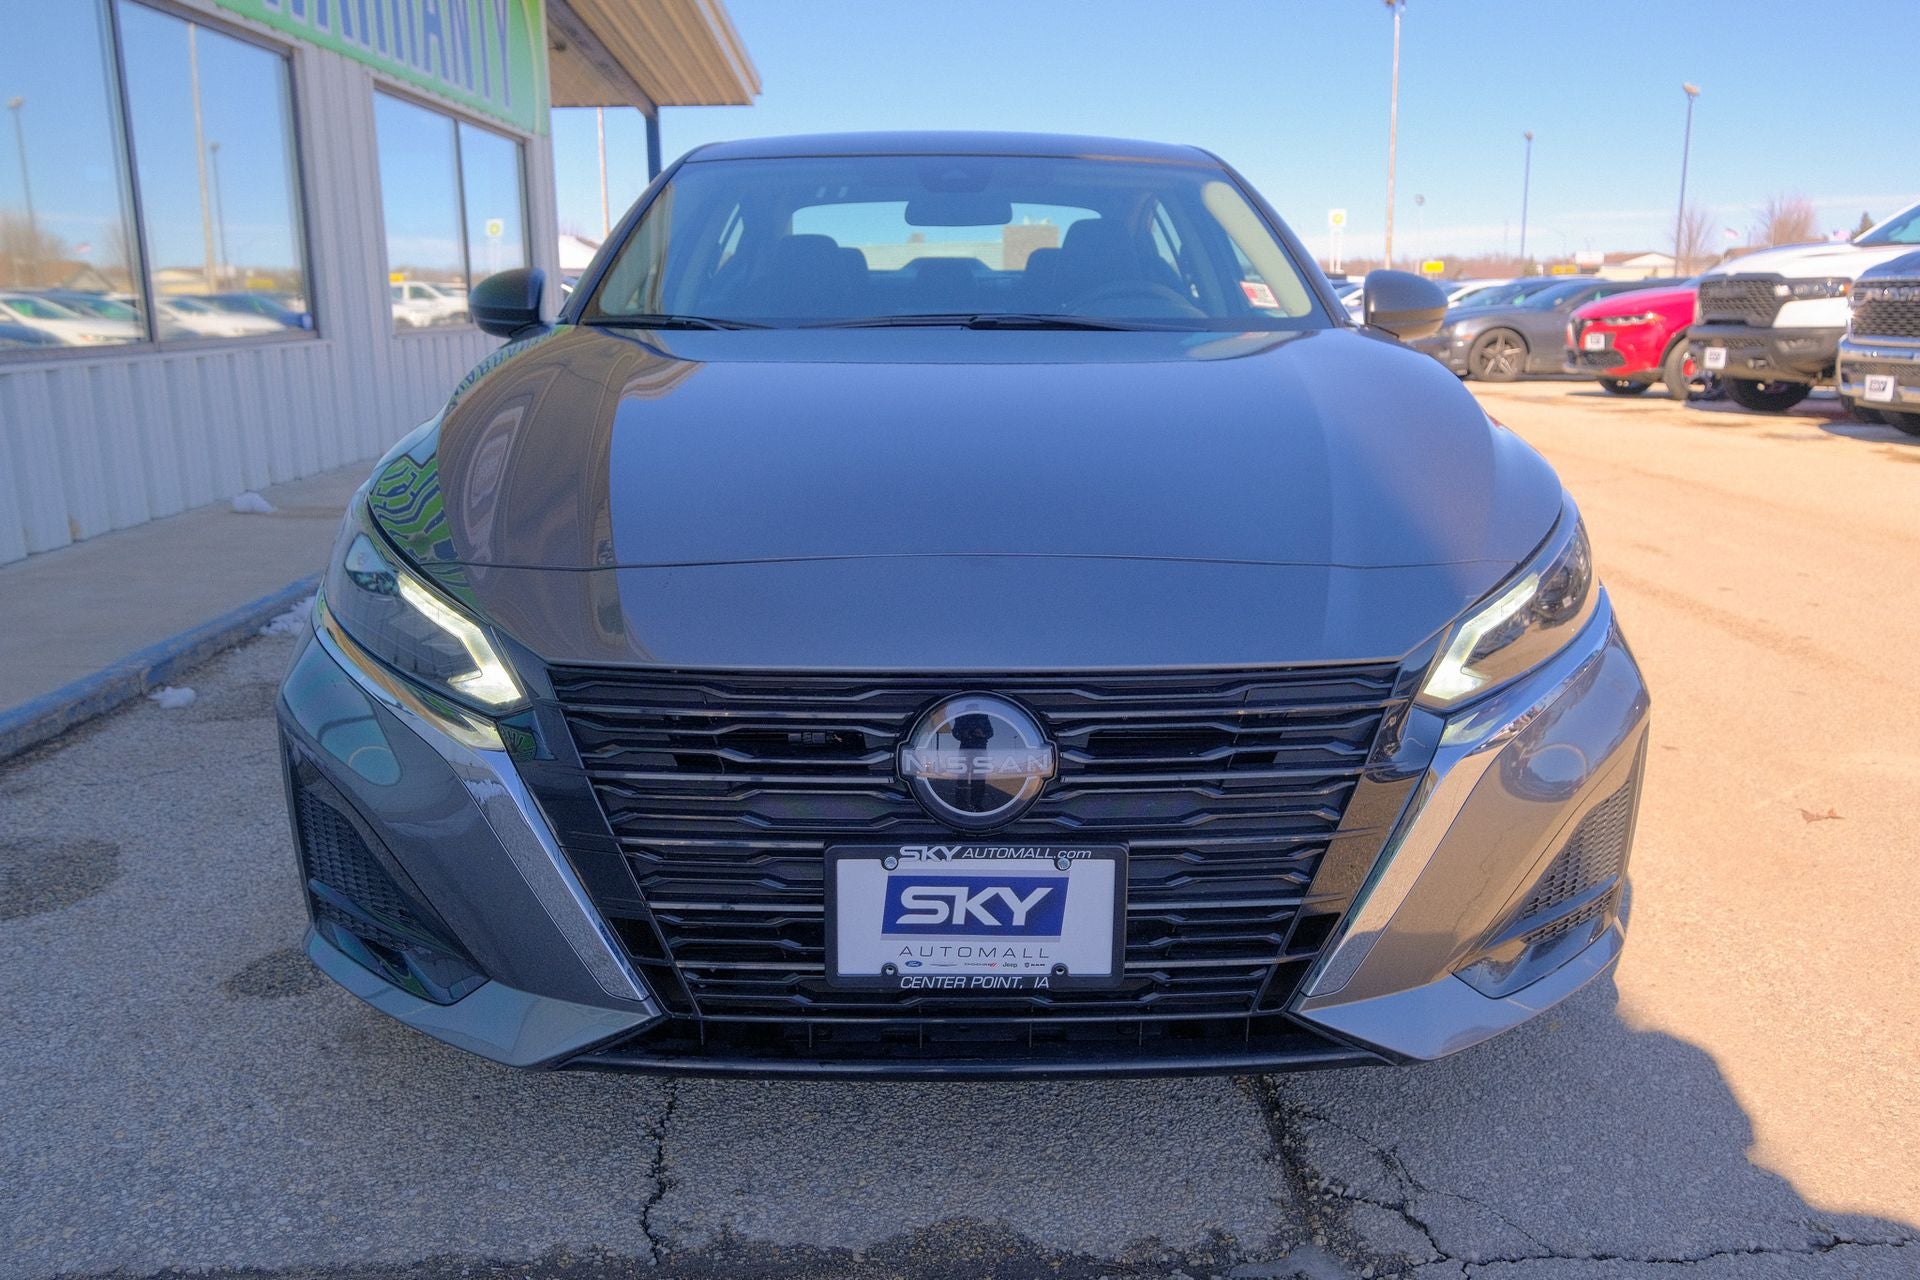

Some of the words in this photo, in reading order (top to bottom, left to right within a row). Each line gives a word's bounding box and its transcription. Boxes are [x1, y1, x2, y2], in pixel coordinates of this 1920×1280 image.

[906, 753, 1049, 774] NISSAN
[900, 845, 962, 862] SKY
[961, 847, 1092, 859] AUTOMALL.com
[896, 886, 1054, 926] SKY
[898, 946, 1049, 959] AUTOMALL
[900, 976, 966, 989] CENTER
[970, 976, 1023, 990] POINT,
[1033, 976, 1050, 989] IA
